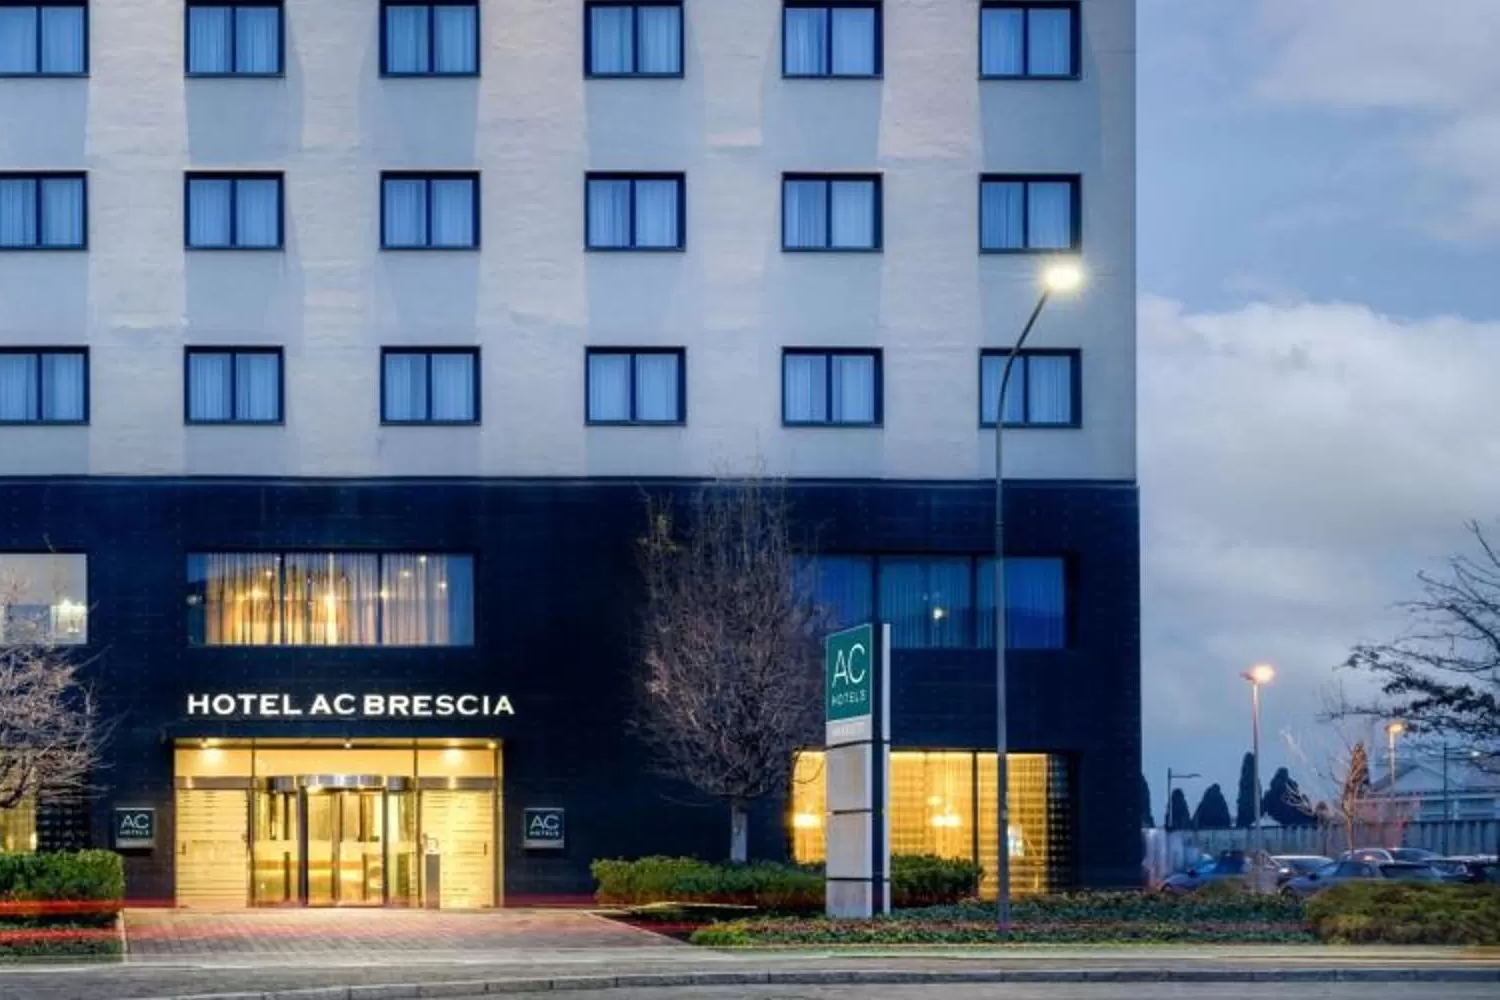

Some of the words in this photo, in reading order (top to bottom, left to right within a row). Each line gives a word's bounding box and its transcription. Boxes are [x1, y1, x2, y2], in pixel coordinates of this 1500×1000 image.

[832, 643, 866, 688] AC
[187, 693, 302, 716] HOTEL
[309, 693, 357, 716] AC
[362, 694, 516, 717] BRESCIA
[831, 688, 867, 707] HOTELS
[120, 813, 150, 829] AC
[530, 814, 560, 829] AC
